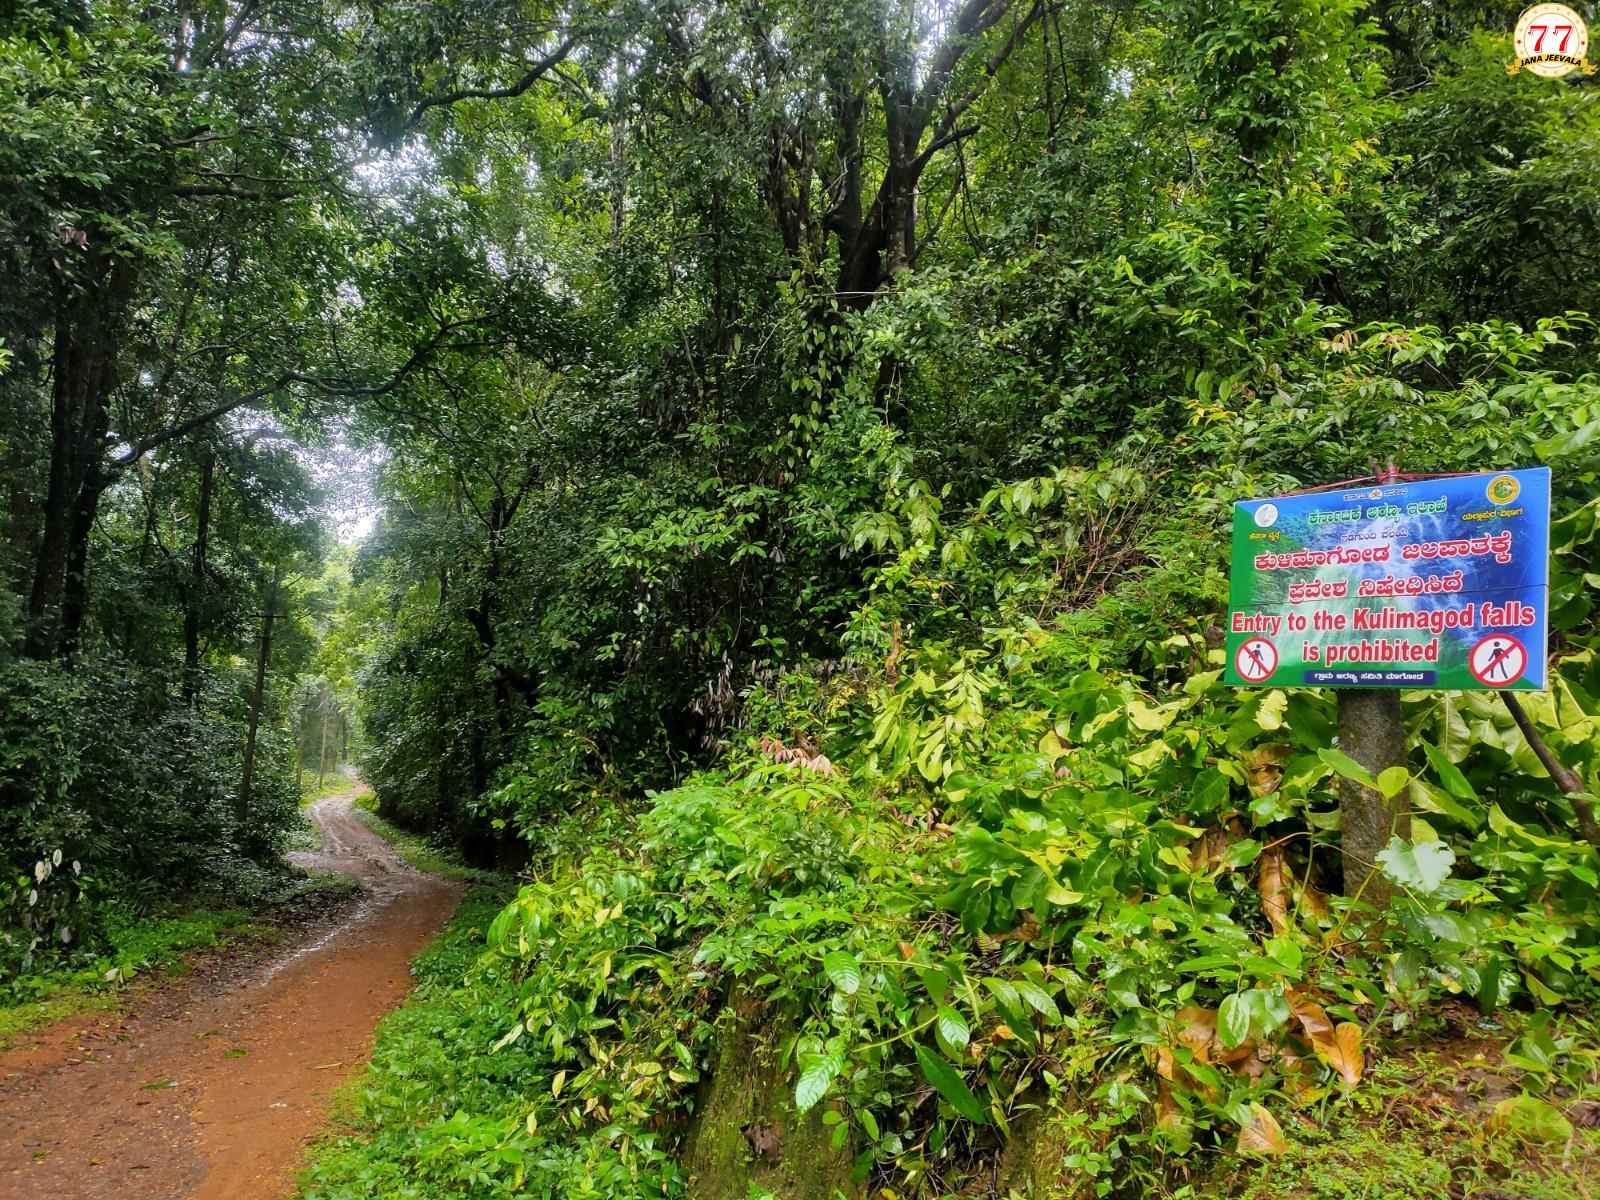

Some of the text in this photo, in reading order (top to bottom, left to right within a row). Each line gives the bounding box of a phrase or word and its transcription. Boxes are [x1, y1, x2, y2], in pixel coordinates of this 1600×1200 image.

[1308, 496, 1447, 525] ಕರ್ನಾಟಕ ಅರಣ್ಯ ಇಲಾಖೆ
[1381, 528, 1408, 539] ವಲಯ
[1254, 531, 1512, 570] ಕುಳಿಮಾಗೋಡ ಜಲಪಾತಕ್ಕೆ
[1288, 570, 1463, 604] ಪ್ರವೇಶ ನಿಷೇಧಿಸಿದೆ
[1231, 601, 1535, 637] Entry to the Kulimagod falls
[1302, 638, 1439, 668] is prohibited
